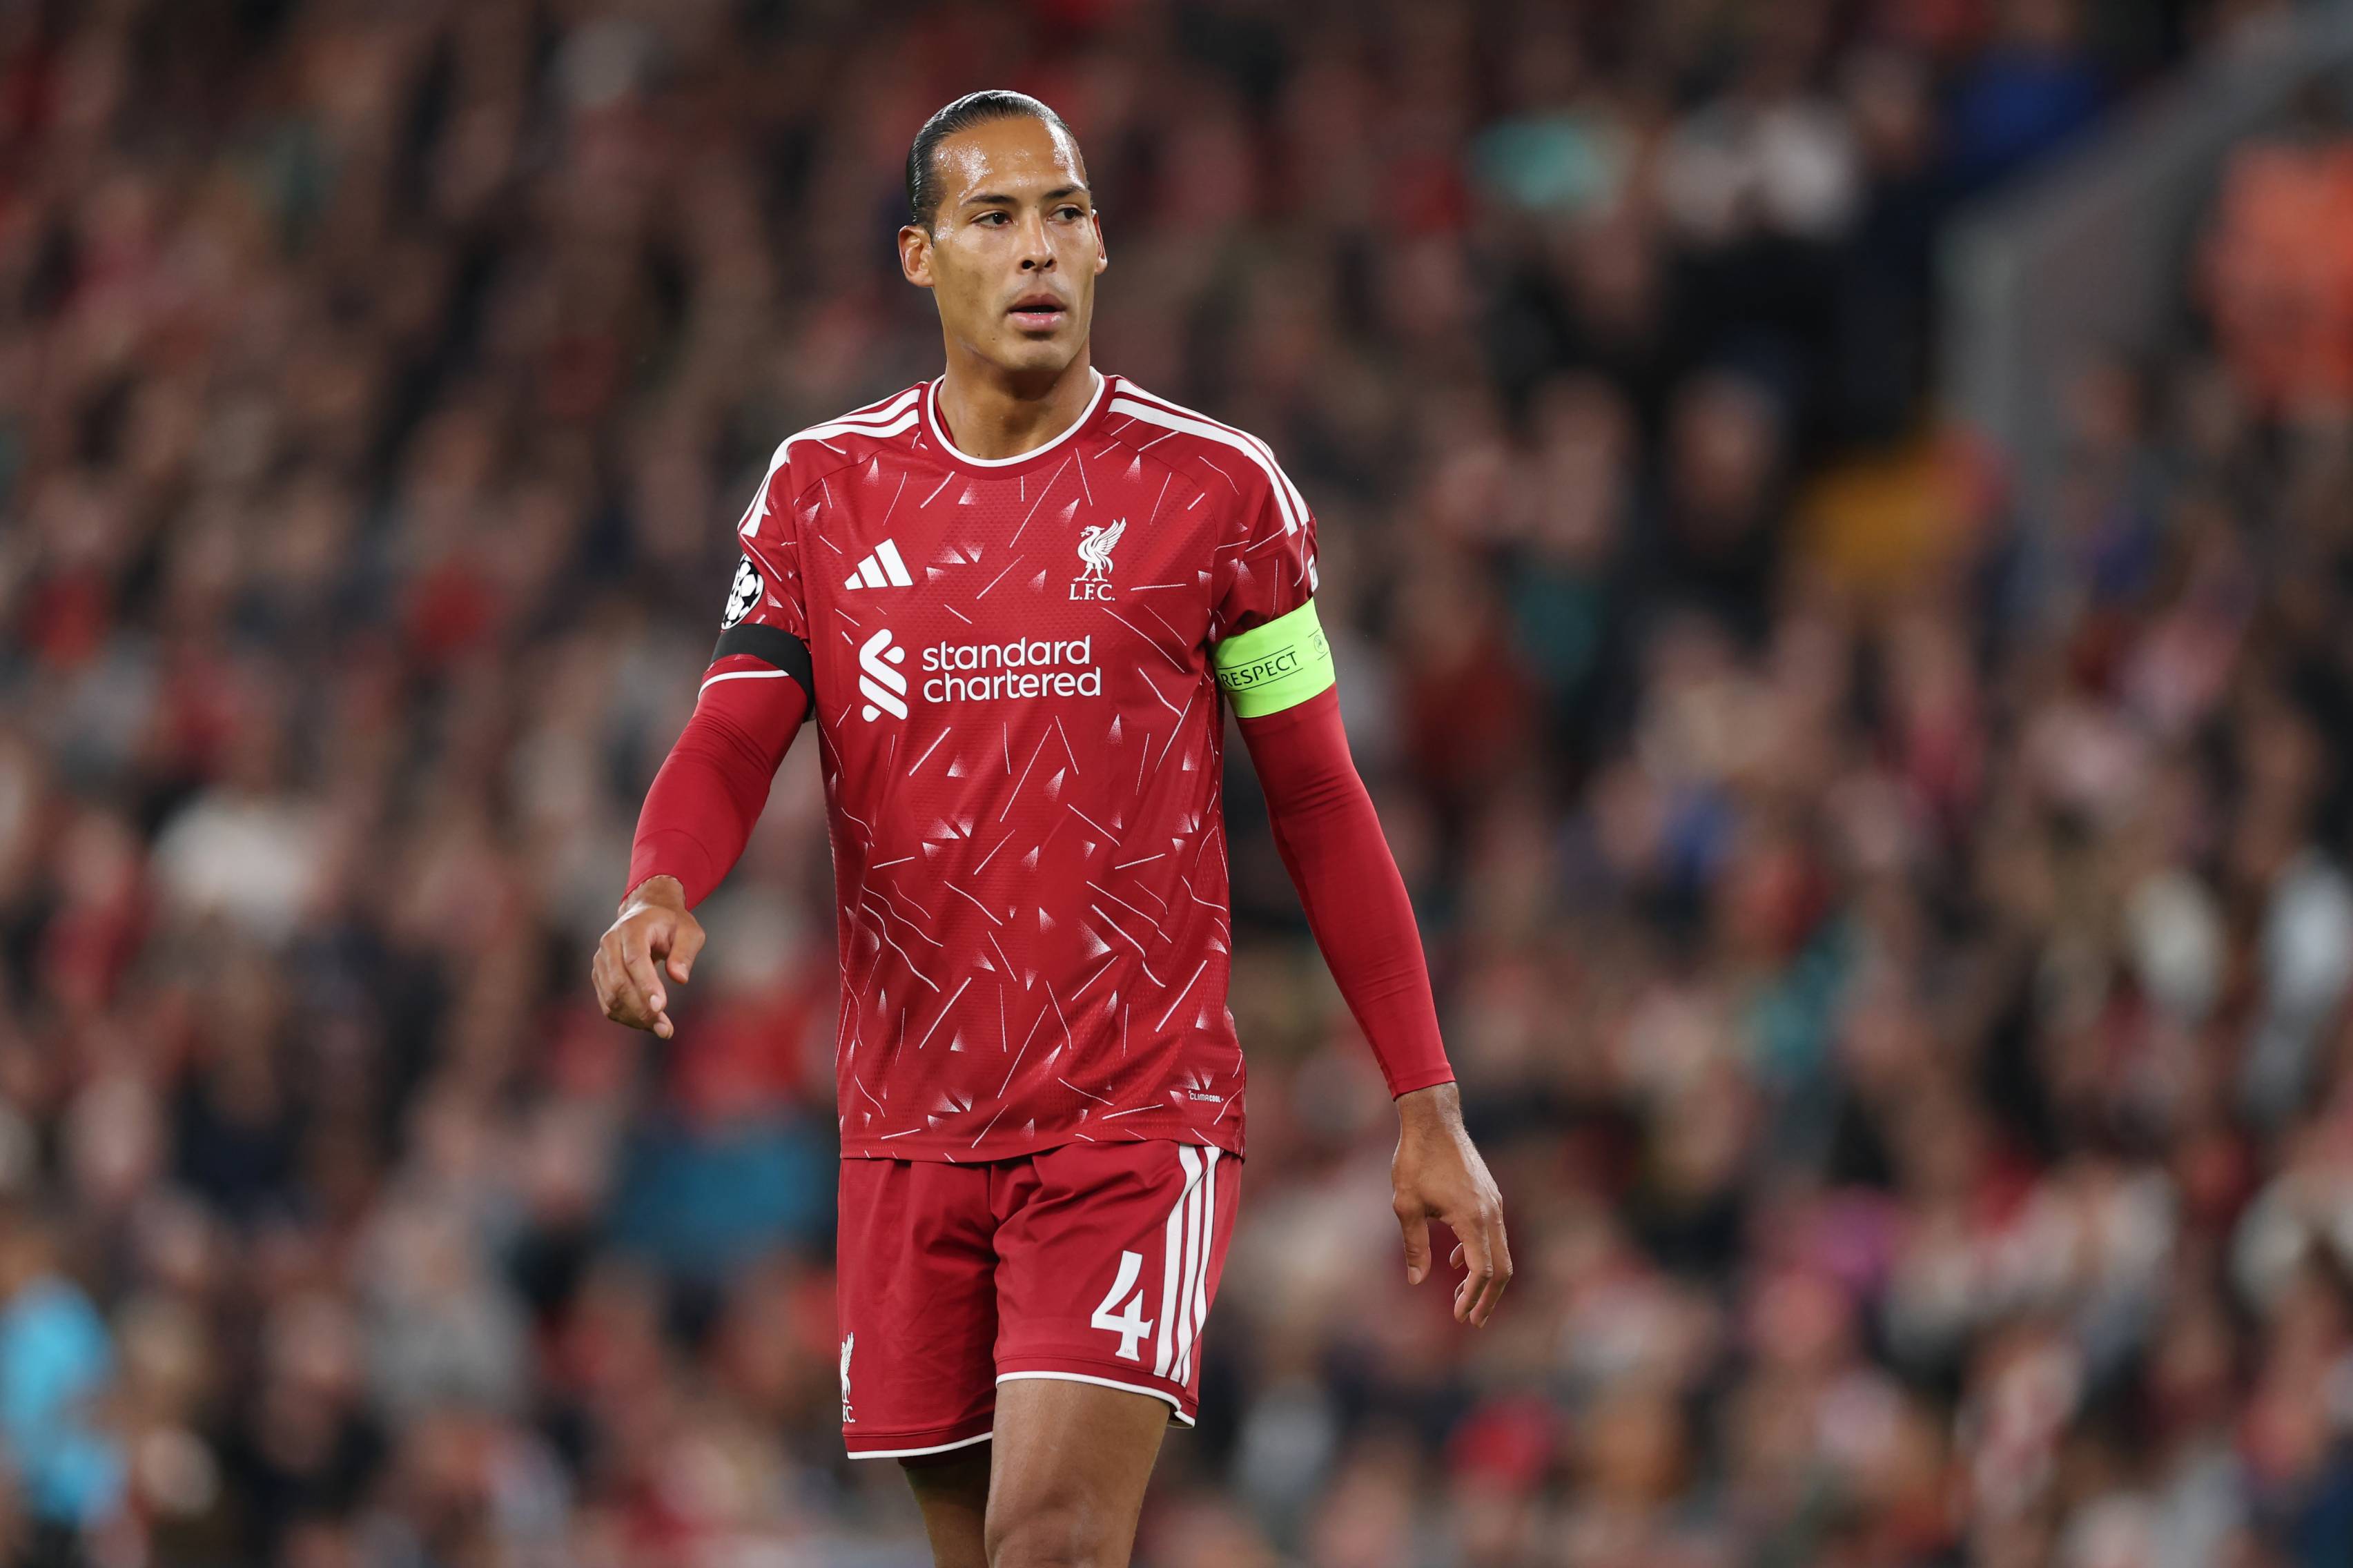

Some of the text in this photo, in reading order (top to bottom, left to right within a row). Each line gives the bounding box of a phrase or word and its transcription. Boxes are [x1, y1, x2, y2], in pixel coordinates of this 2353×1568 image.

[1069, 583, 1115, 601] L.F.C.
[923, 634, 1091, 672] standard
[1220, 651, 1298, 687] RESPECT
[923, 667, 1101, 703] chartered
[1189, 1092, 1222, 1104] CLIMACOOL
[1091, 1250, 1154, 1362] 4
